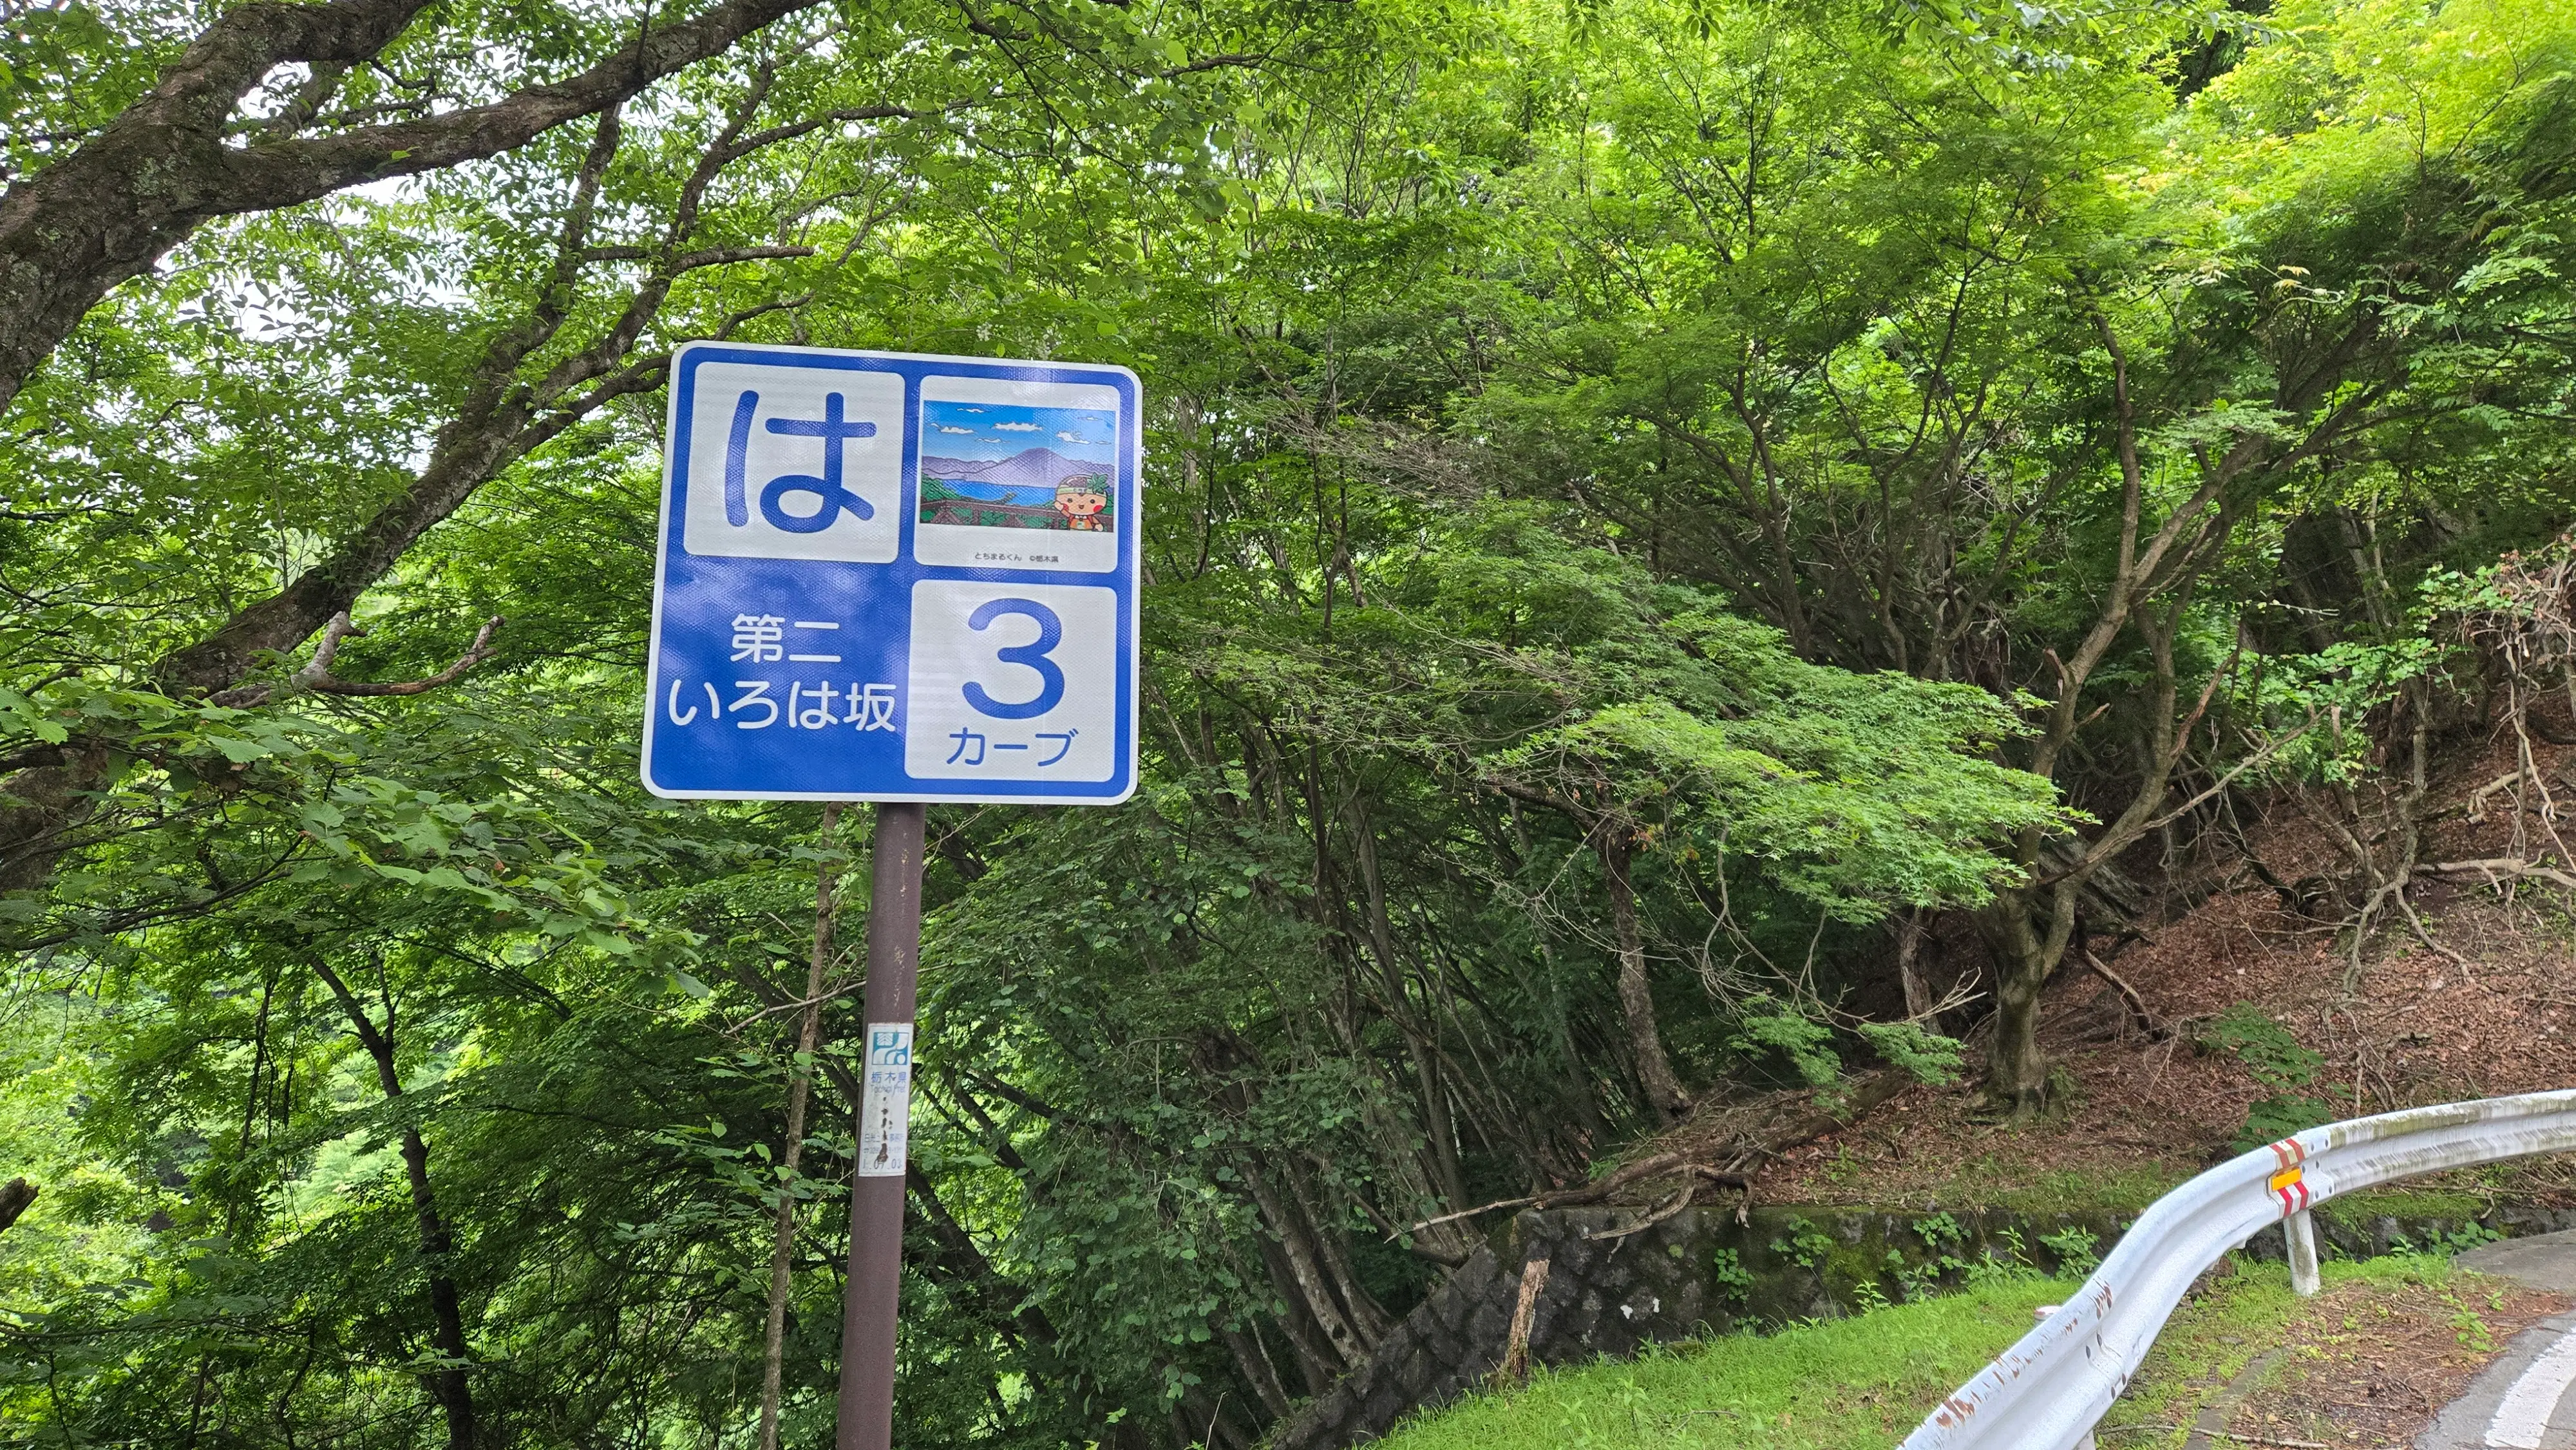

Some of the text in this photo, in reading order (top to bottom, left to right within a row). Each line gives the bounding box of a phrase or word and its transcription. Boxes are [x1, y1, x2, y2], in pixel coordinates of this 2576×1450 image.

[725, 390, 876, 534] は
[974, 552, 1022, 562] とちまるくん
[730, 613, 842, 664] 第二
[961, 598, 1065, 720] 3
[668, 679, 896, 732] いろは坂
[947, 727, 1079, 767] カーブ
[871, 1071, 907, 1084] 栃木県
